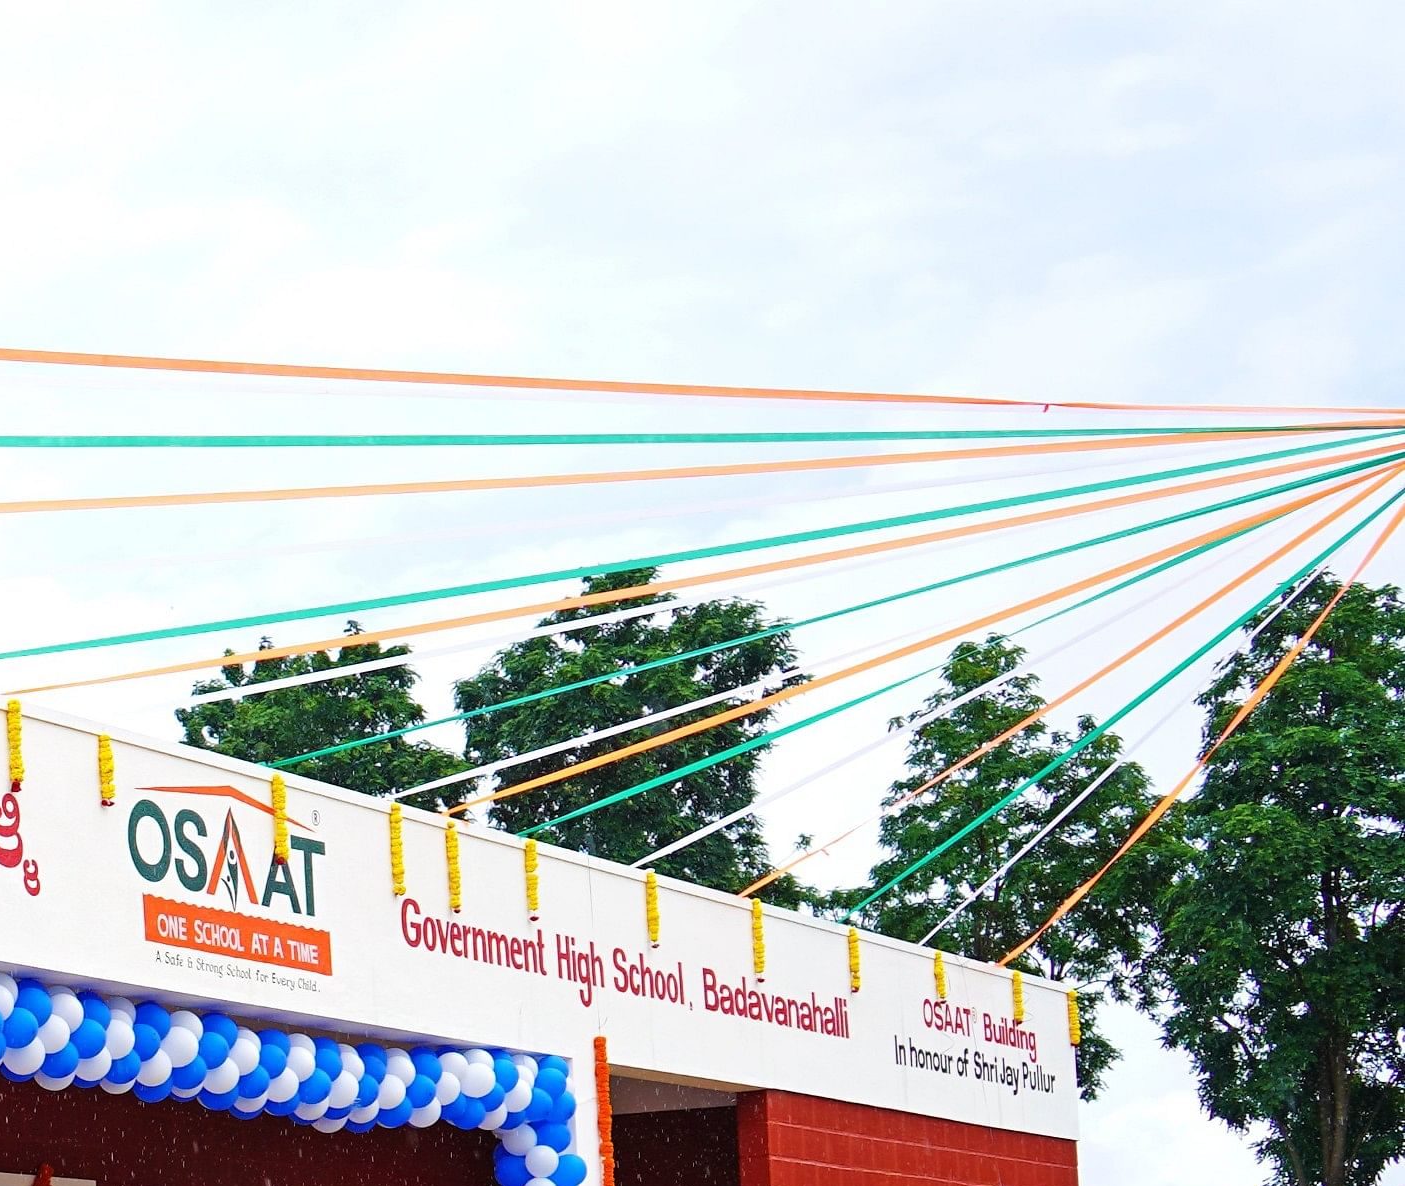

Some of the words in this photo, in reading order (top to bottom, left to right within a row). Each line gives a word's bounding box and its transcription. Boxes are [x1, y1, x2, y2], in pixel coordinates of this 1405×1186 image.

[157, 913, 188, 941] ONE
[194, 920, 245, 951] SCHOOL
[251, 933, 270, 956] AT
[273, 934, 285, 959] A
[287, 940, 319, 965] TIME
[155, 950, 162, 963] A
[164, 951, 183, 967] Safe
[196, 957, 224, 978] Strong
[227, 963, 252, 980] School
[255, 969, 270, 983] for
[272, 972, 296, 991] Every
[401, 898, 547, 976] Government
[555, 933, 605, 1008] High
[613, 947, 693, 1011] School,
[702, 967, 850, 1039] Badavanahalli
[983, 1013, 1037, 1063] Building
[894, 1035, 907, 1066] In
[909, 1037, 953, 1074] honour
[956, 1048, 969, 1077] of
[973, 1050, 999, 1083] Shri
[999, 1057, 1019, 1095] Jay
[1022, 1061, 1056, 1094] Pullur
